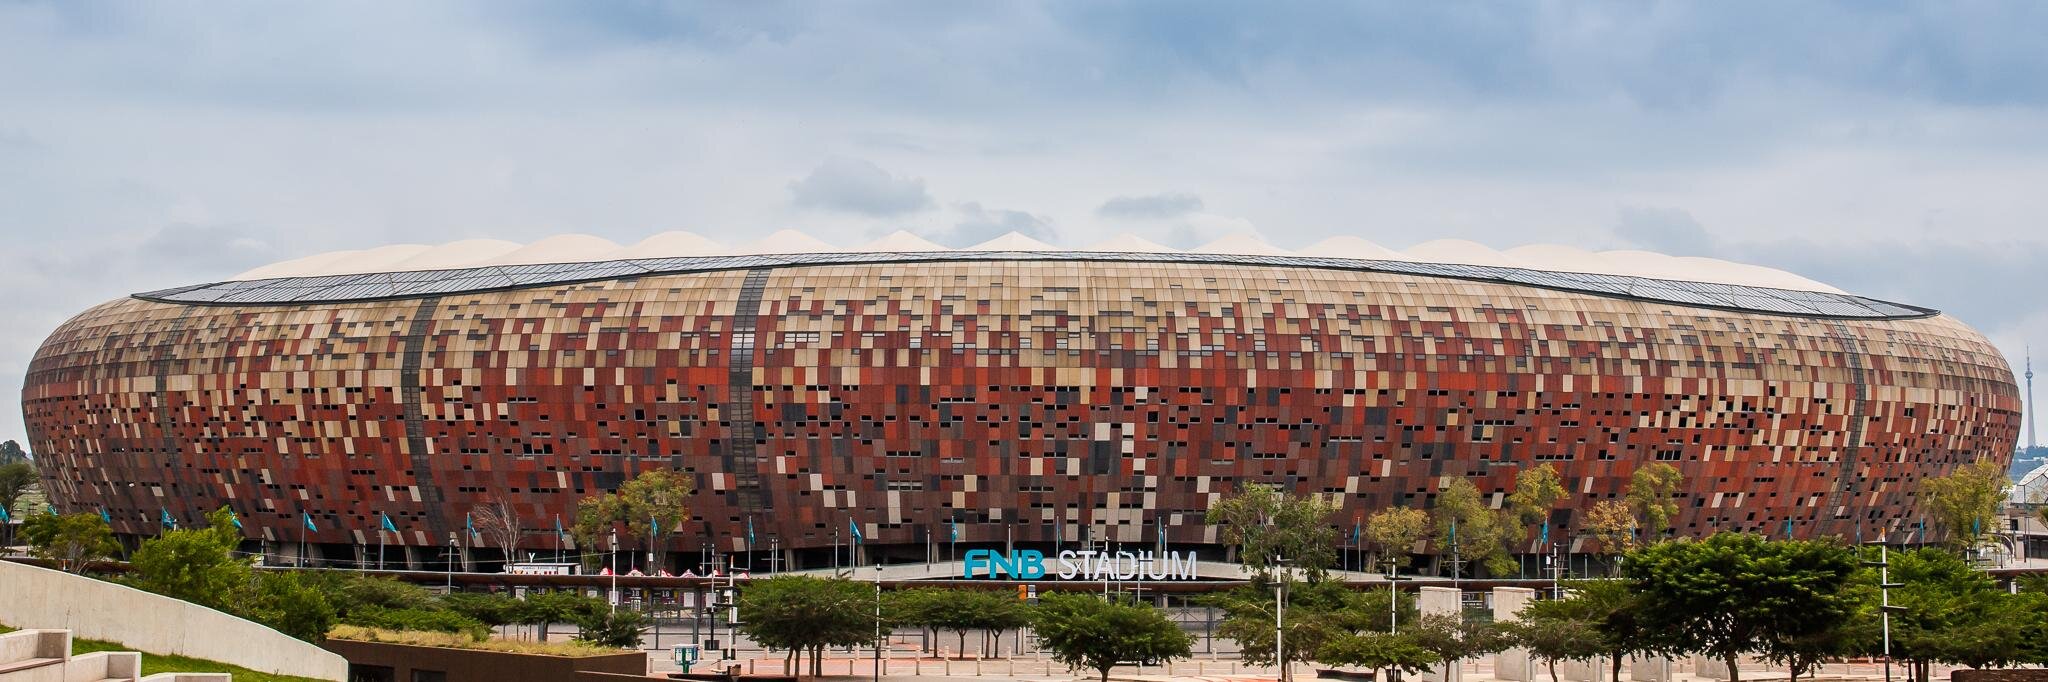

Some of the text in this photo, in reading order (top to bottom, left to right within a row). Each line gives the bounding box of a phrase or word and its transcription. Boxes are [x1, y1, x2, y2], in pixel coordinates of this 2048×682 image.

[964, 549, 1197, 580] FNB STADIUM
[661, 590, 670, 598] 18
